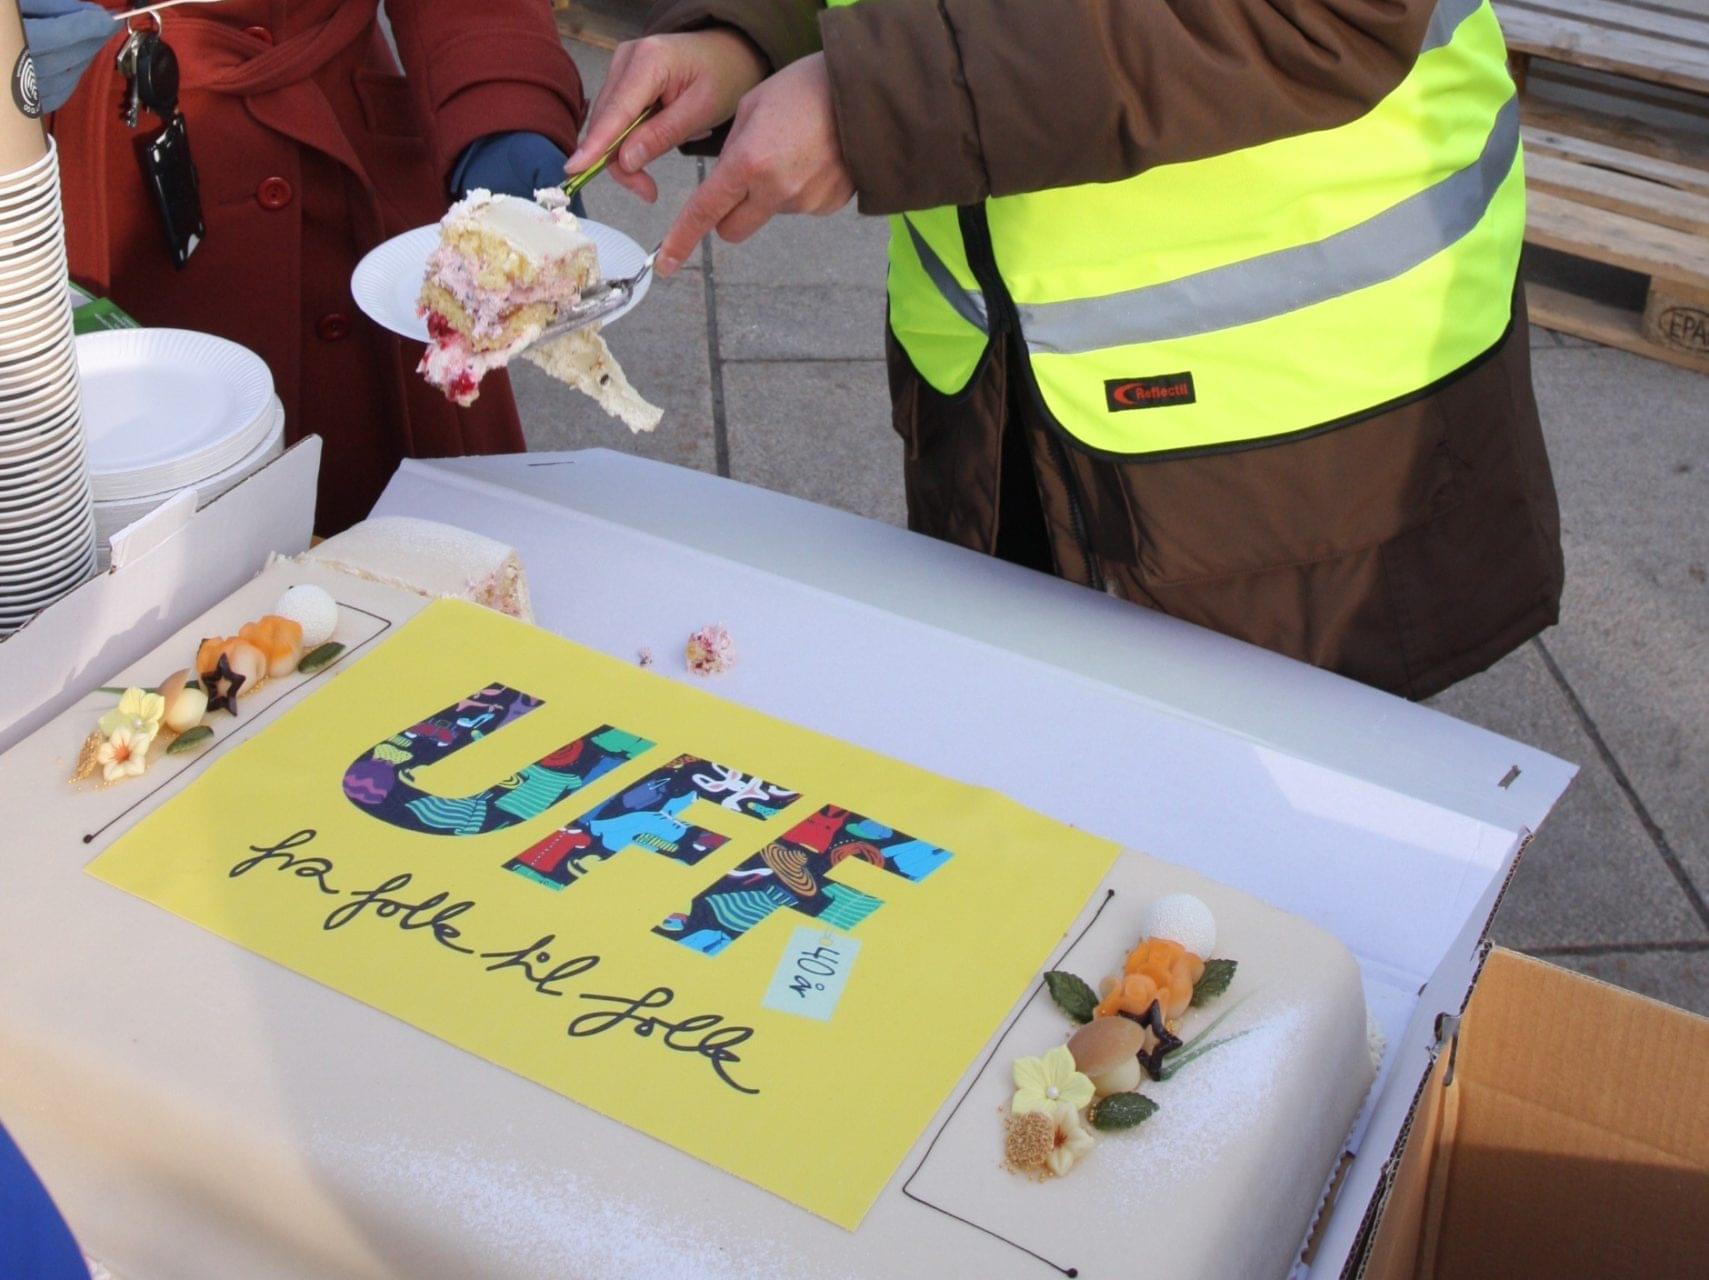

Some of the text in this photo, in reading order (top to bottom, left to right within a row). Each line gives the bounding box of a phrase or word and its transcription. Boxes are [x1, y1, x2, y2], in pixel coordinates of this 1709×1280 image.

[1670, 311, 1709, 345] EPA
[342, 682, 955, 956] UFF
[229, 829, 761, 1095] fra folk til folk
[788, 946, 841, 999] 40 år
